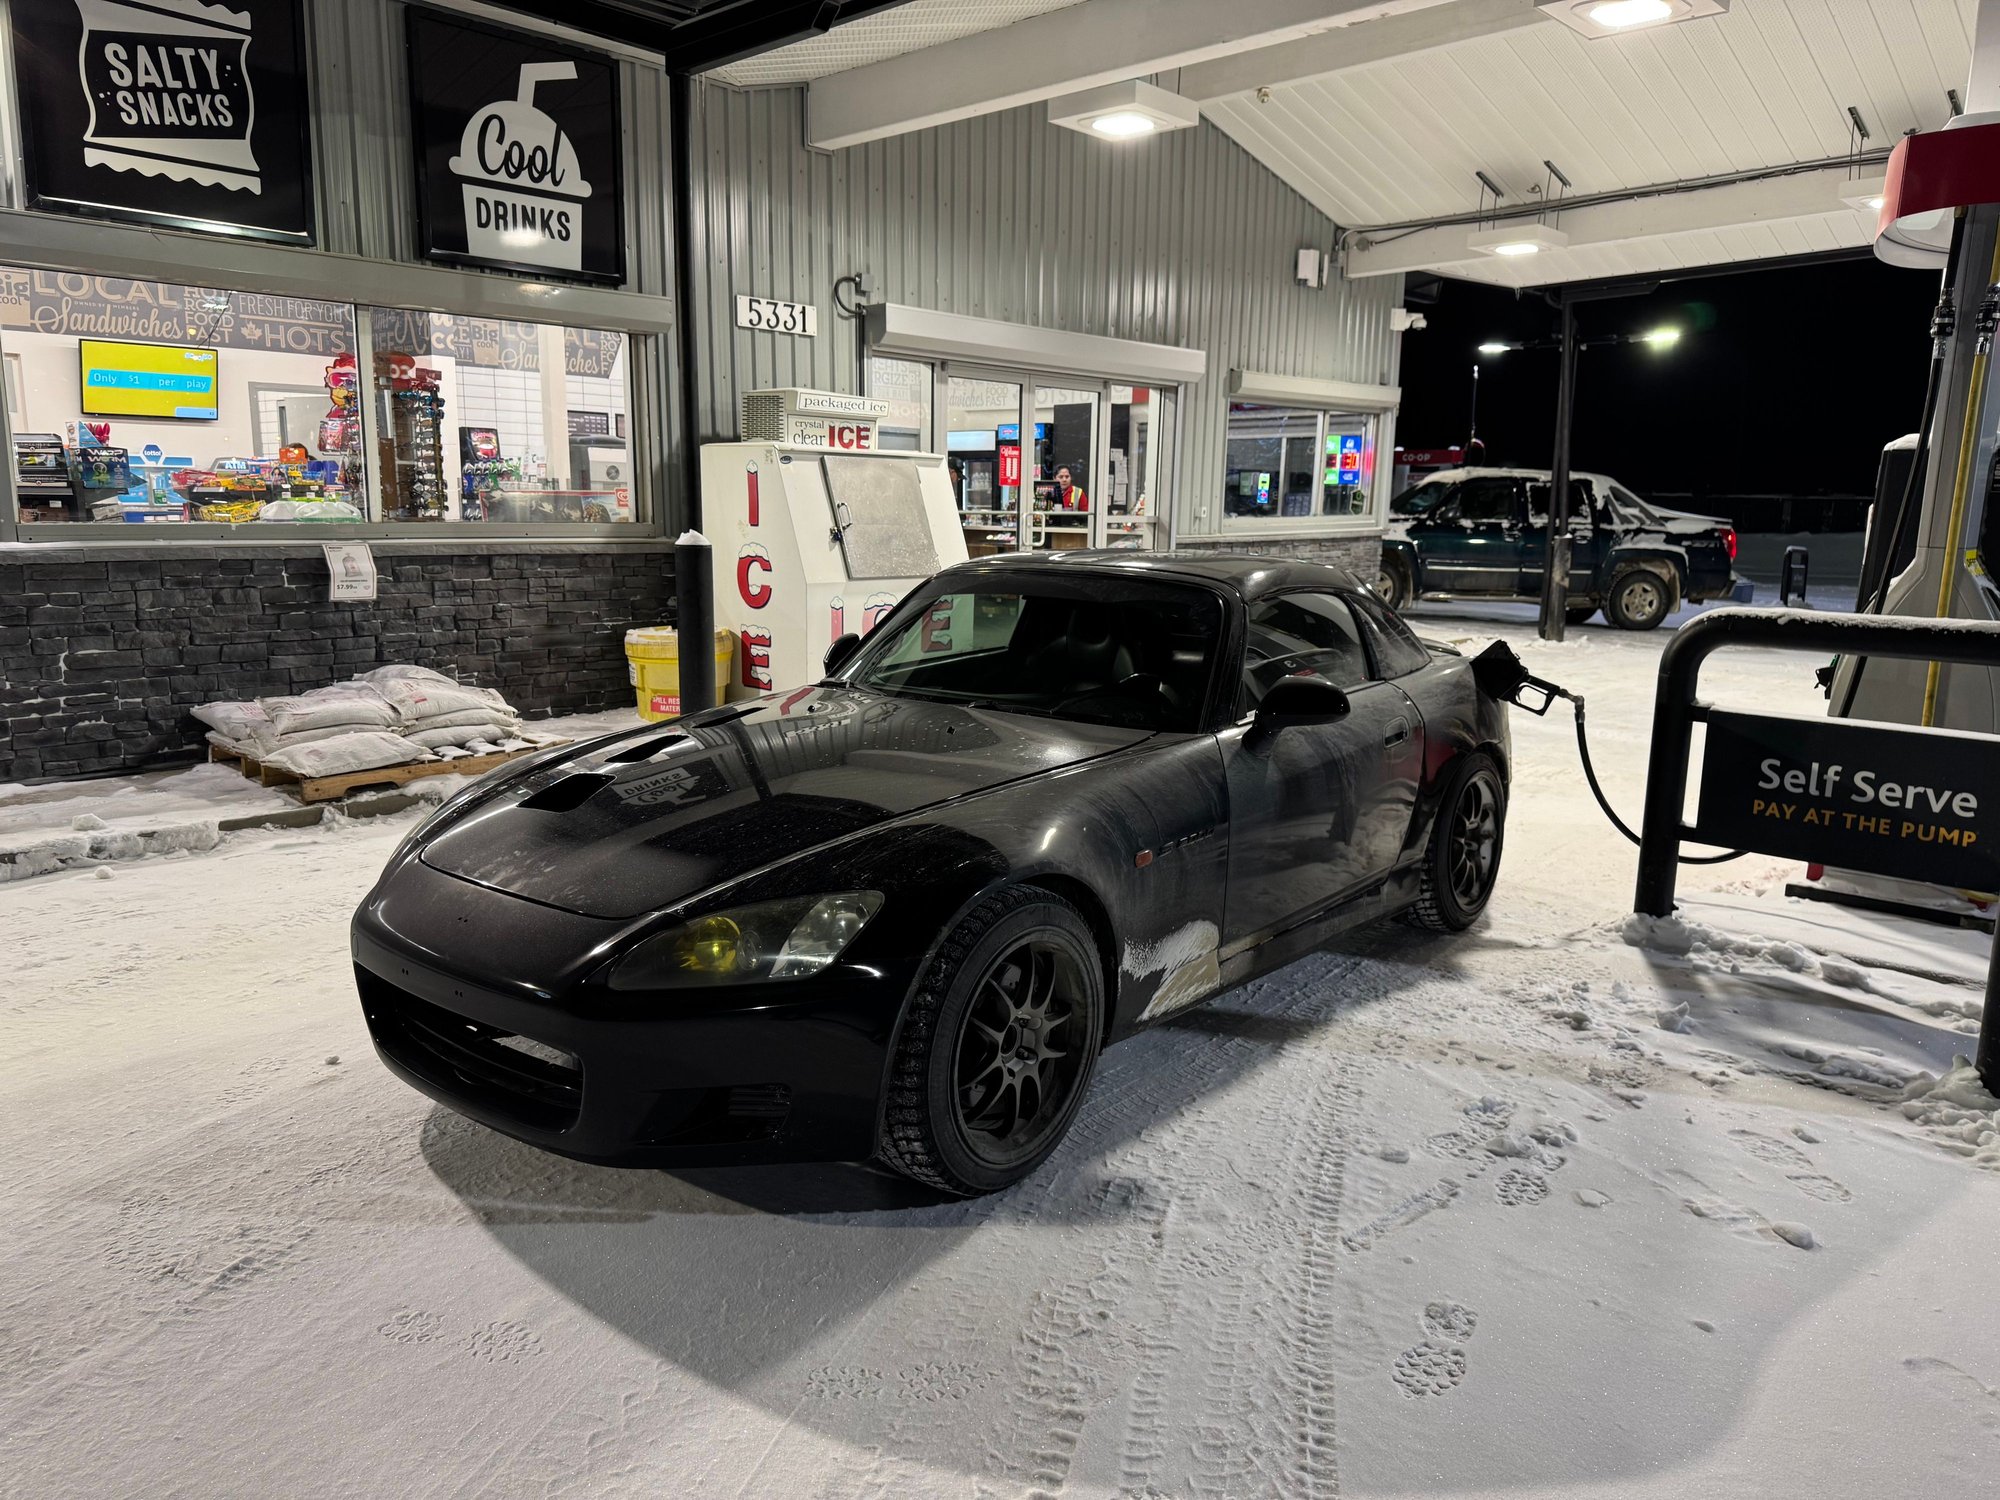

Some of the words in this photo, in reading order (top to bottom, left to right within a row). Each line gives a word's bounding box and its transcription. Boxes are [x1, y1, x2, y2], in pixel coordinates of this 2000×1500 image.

[104, 42, 220, 90] SALTY
[116, 90, 233, 127] SNACKS
[477, 113, 565, 187] Cool
[475, 197, 570, 242] DRINKS
[33, 270, 179, 309] LOCAL
[34, 297, 184, 339] Sandwiches
[185, 311, 234, 327] FOOD
[239, 294, 283, 320] FRESH
[286, 299, 313, 321] FOR
[317, 303, 342, 324] YOU
[748, 298, 808, 333] 5331
[186, 325, 232, 343] FAST
[471, 323, 499, 345] Big
[93, 372, 117, 384] Only
[128, 375, 140, 385] $1
[159, 378, 176, 388] per
[186, 379, 207, 390] play
[804, 397, 865, 412] packaged
[869, 402, 887, 413] ice
[793, 430, 825, 446] clear
[794, 419, 825, 430] crystal
[828, 421, 871, 449] ICE
[225, 461, 246, 470] ATM
[1402, 453, 1431, 462] CO-OP
[737, 460, 773, 691] ICE
[1758, 758, 1842, 798] Self
[1850, 770, 1978, 818] Serve
[1753, 799, 1797, 820] PAY
[1803, 807, 1836, 826] AT
[1843, 812, 1891, 835] THE
[1901, 822, 1978, 847] PUMP
